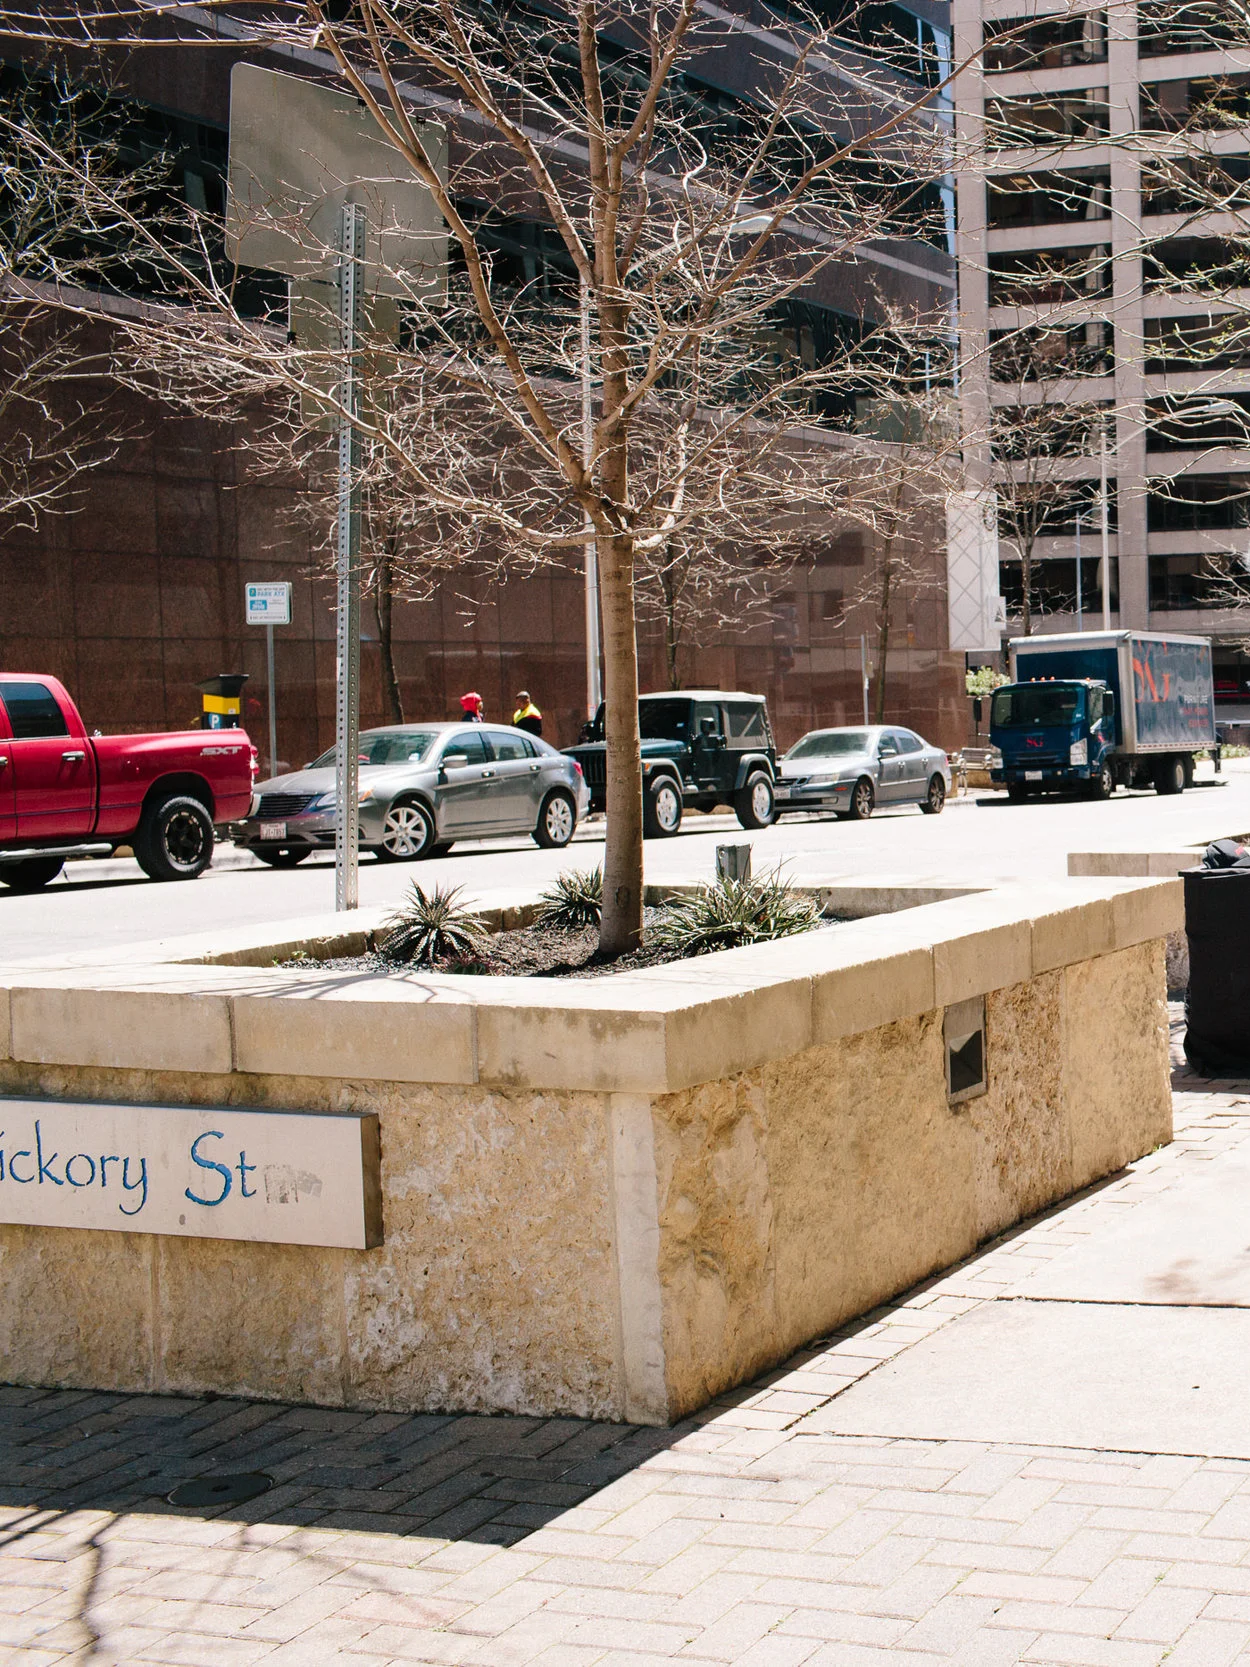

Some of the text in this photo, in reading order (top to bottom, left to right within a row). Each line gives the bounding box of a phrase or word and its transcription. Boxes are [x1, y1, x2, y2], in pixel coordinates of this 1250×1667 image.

[211, 714, 220, 729] P
[201, 745, 243, 757] SXT
[184, 1130, 257, 1207] St
